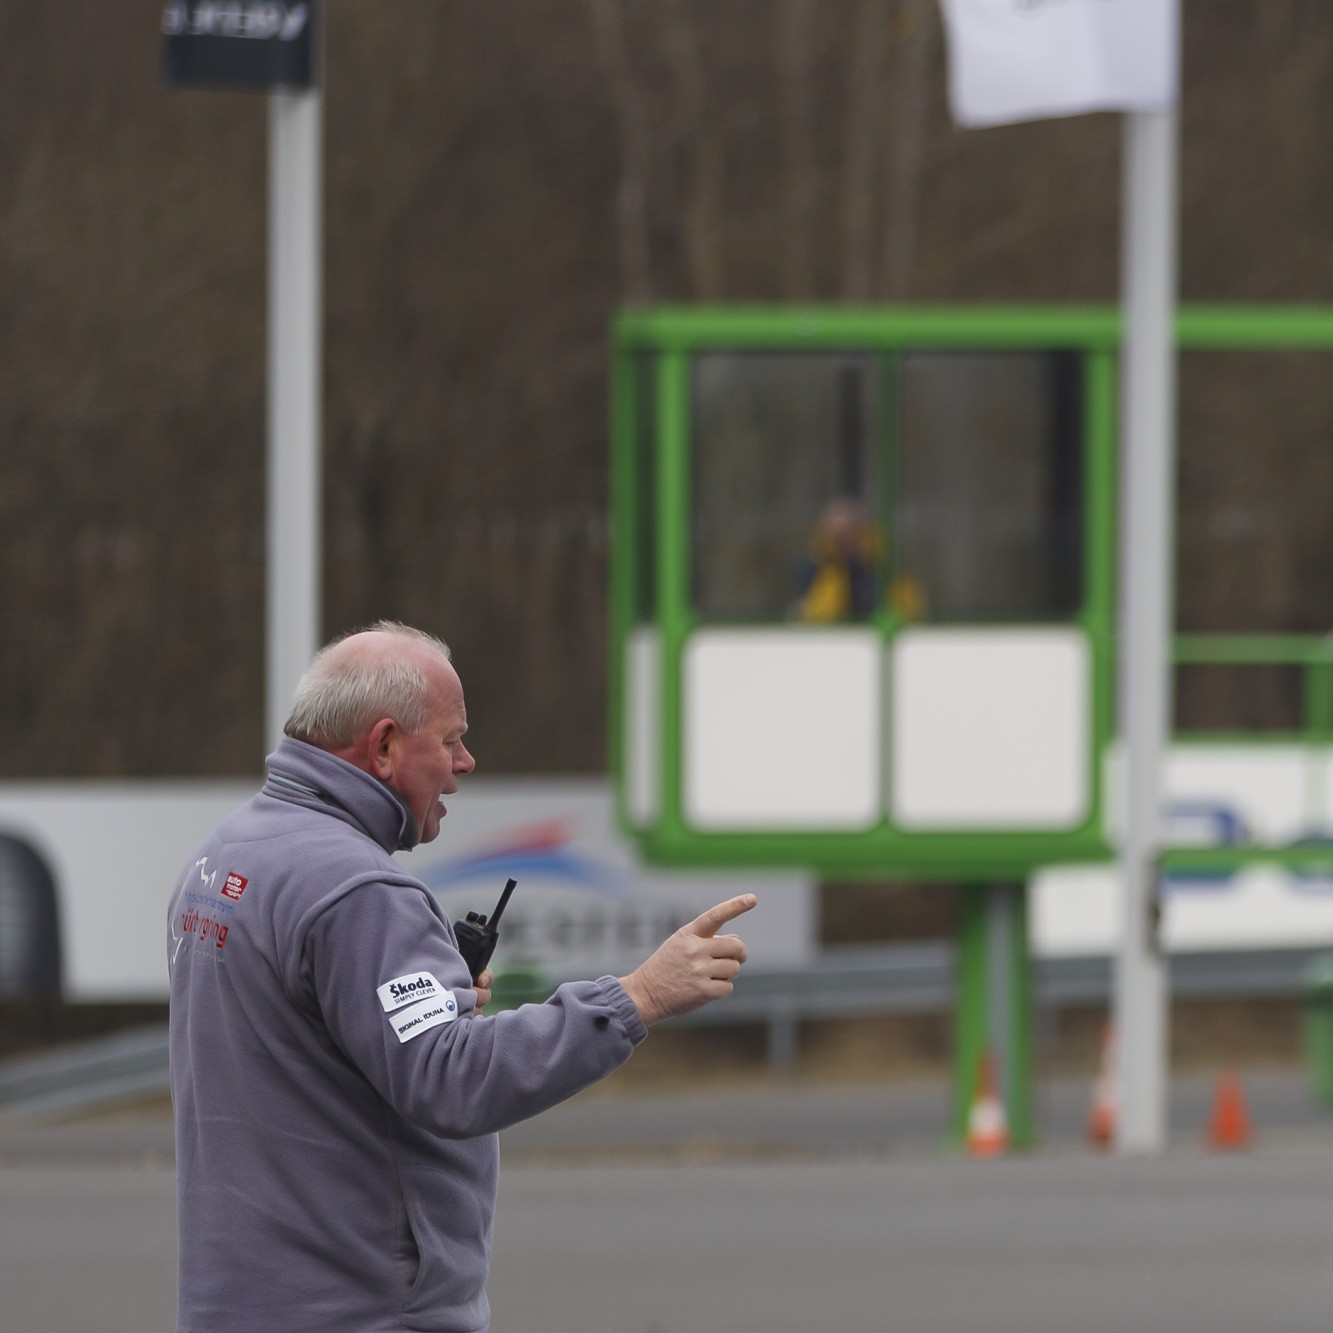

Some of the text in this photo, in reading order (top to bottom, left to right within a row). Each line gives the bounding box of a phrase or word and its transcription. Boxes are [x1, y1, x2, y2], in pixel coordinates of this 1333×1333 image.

[389, 977, 433, 998] Škoda
[394, 988, 436, 1004] SIMPLY CLEVER
[398, 1007, 445, 1034] SIGNAL IDUNA
